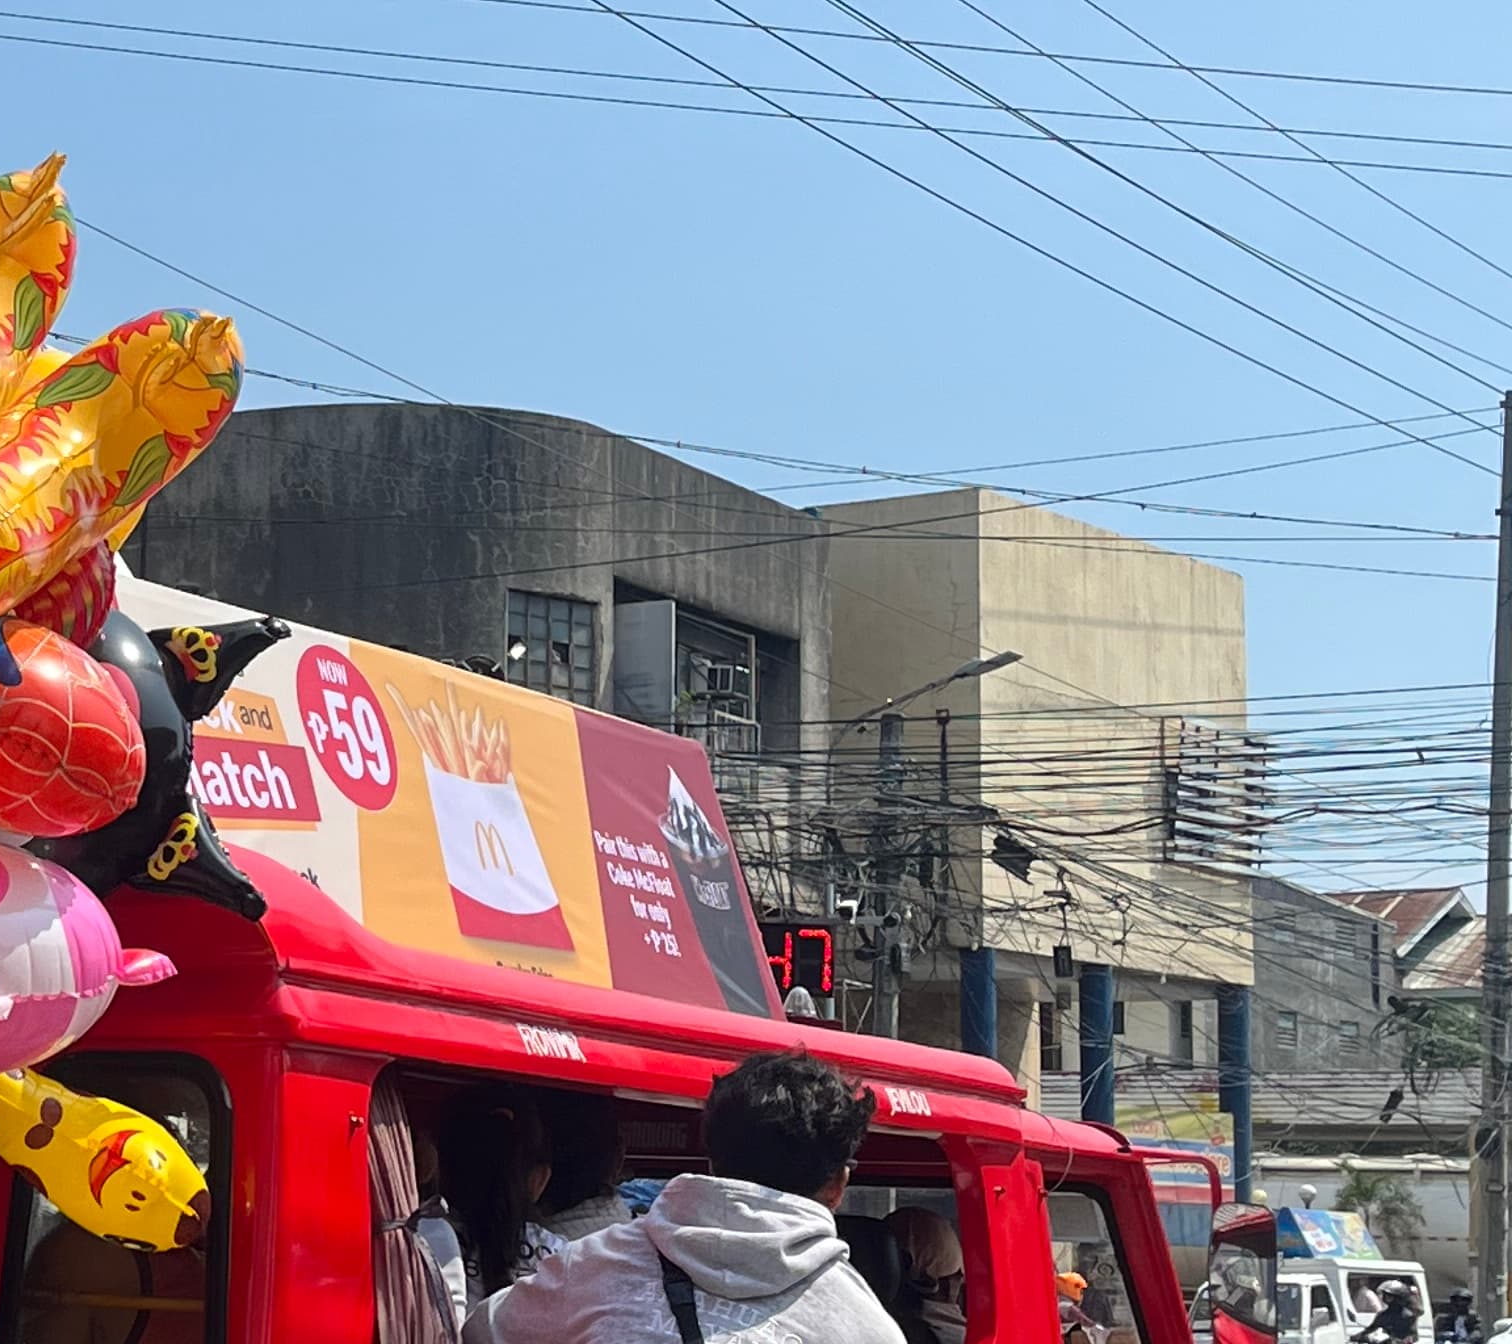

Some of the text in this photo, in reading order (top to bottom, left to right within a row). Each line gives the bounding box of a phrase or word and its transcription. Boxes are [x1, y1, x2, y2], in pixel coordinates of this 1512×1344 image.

[316, 657, 348, 687] NOW
[240, 705, 273, 731] and
[594, 830, 669, 868] Pair this with a
[607, 861, 635, 888] Coke
[633, 867, 676, 898] McFloat
[629, 894, 672, 931] for only
